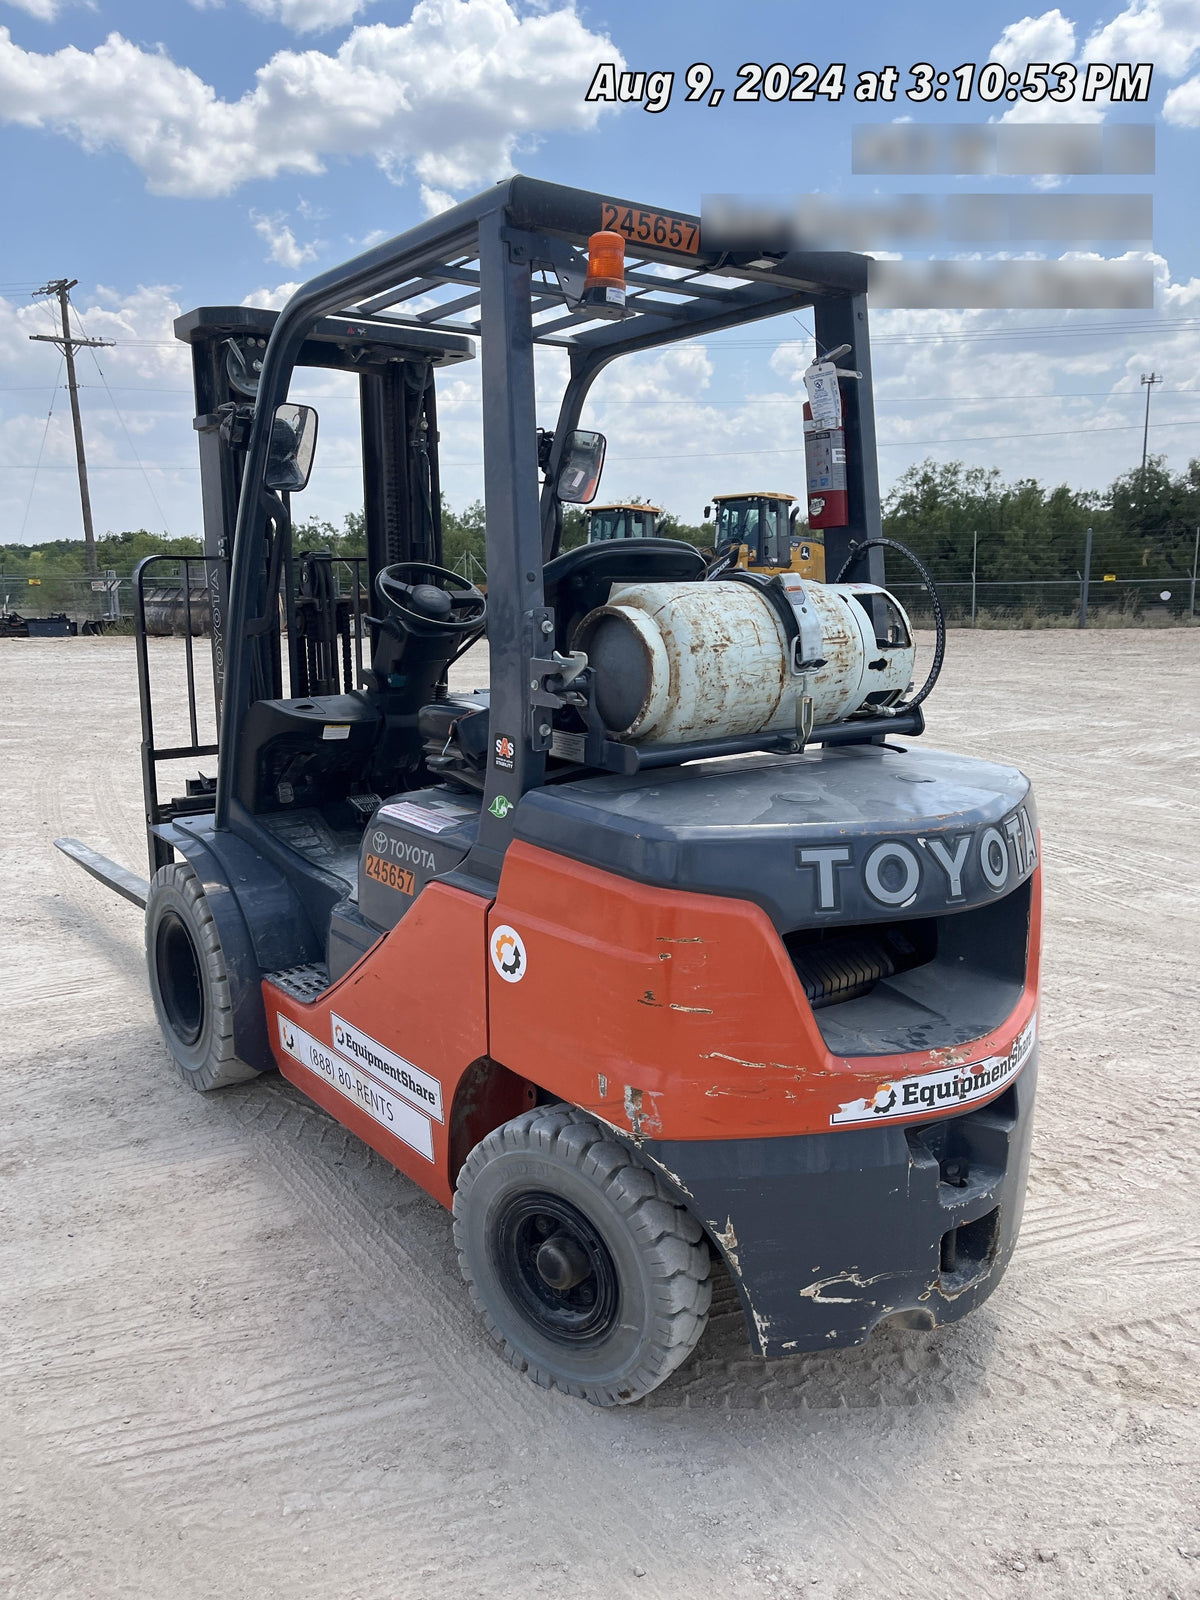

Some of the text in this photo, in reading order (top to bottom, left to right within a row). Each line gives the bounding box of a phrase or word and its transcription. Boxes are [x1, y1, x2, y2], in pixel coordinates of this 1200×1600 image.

[604, 204, 698, 250] 245657
[210, 568, 225, 684] TOYOTA
[495, 737, 514, 758] SAS
[366, 854, 415, 893] 245657
[389, 838, 436, 872] TOYOTA
[797, 805, 1037, 908] TOYOTA
[309, 1045, 394, 1122] (888) 80-RENTS
[346, 1032, 436, 1105] EquipmentShare
